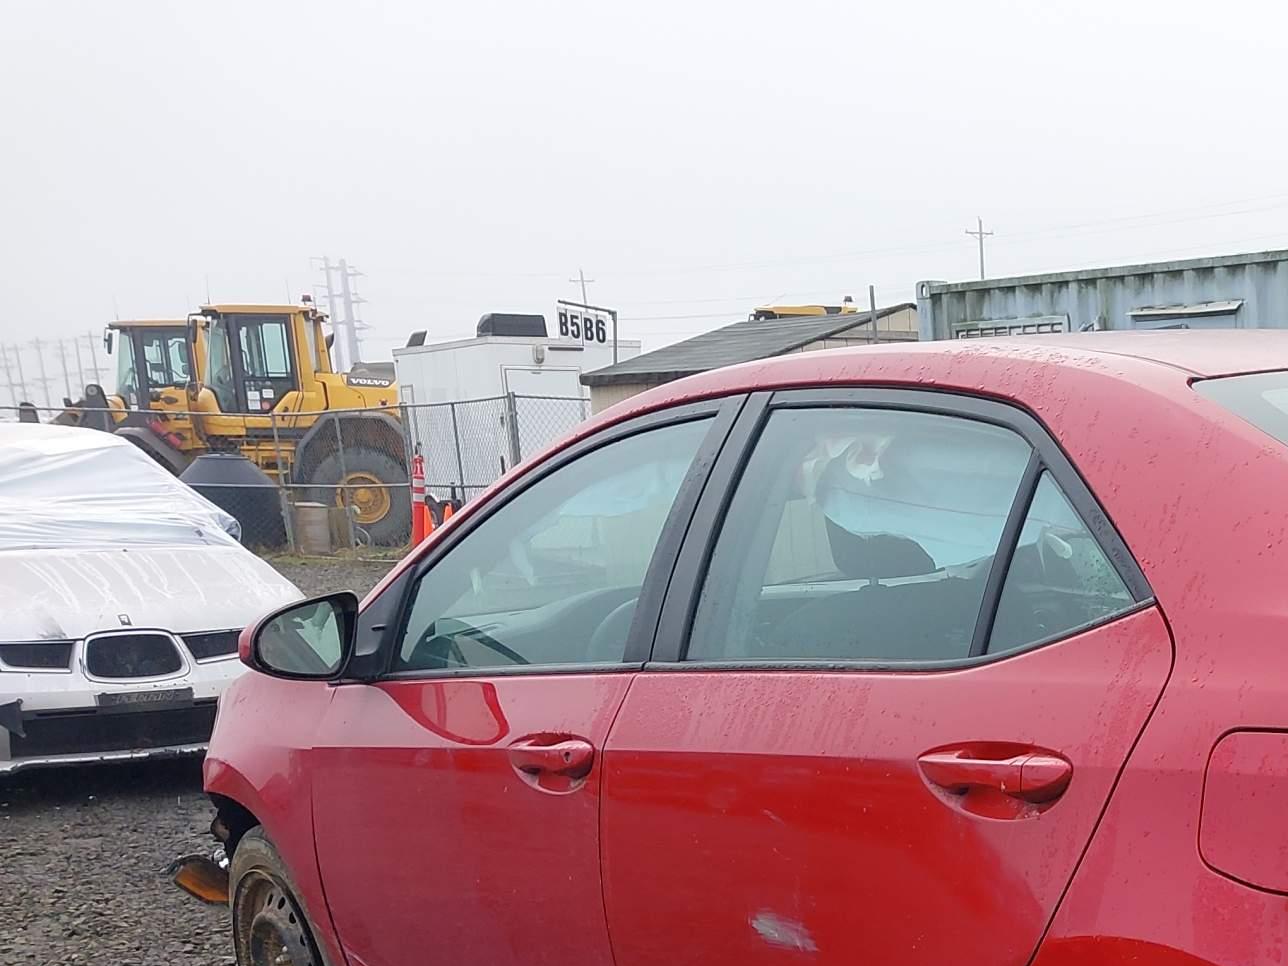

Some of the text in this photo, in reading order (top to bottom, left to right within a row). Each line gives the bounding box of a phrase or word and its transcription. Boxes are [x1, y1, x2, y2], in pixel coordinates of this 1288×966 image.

[558, 311, 606, 344] B5 B6
[350, 378, 390, 386] VOLVO
